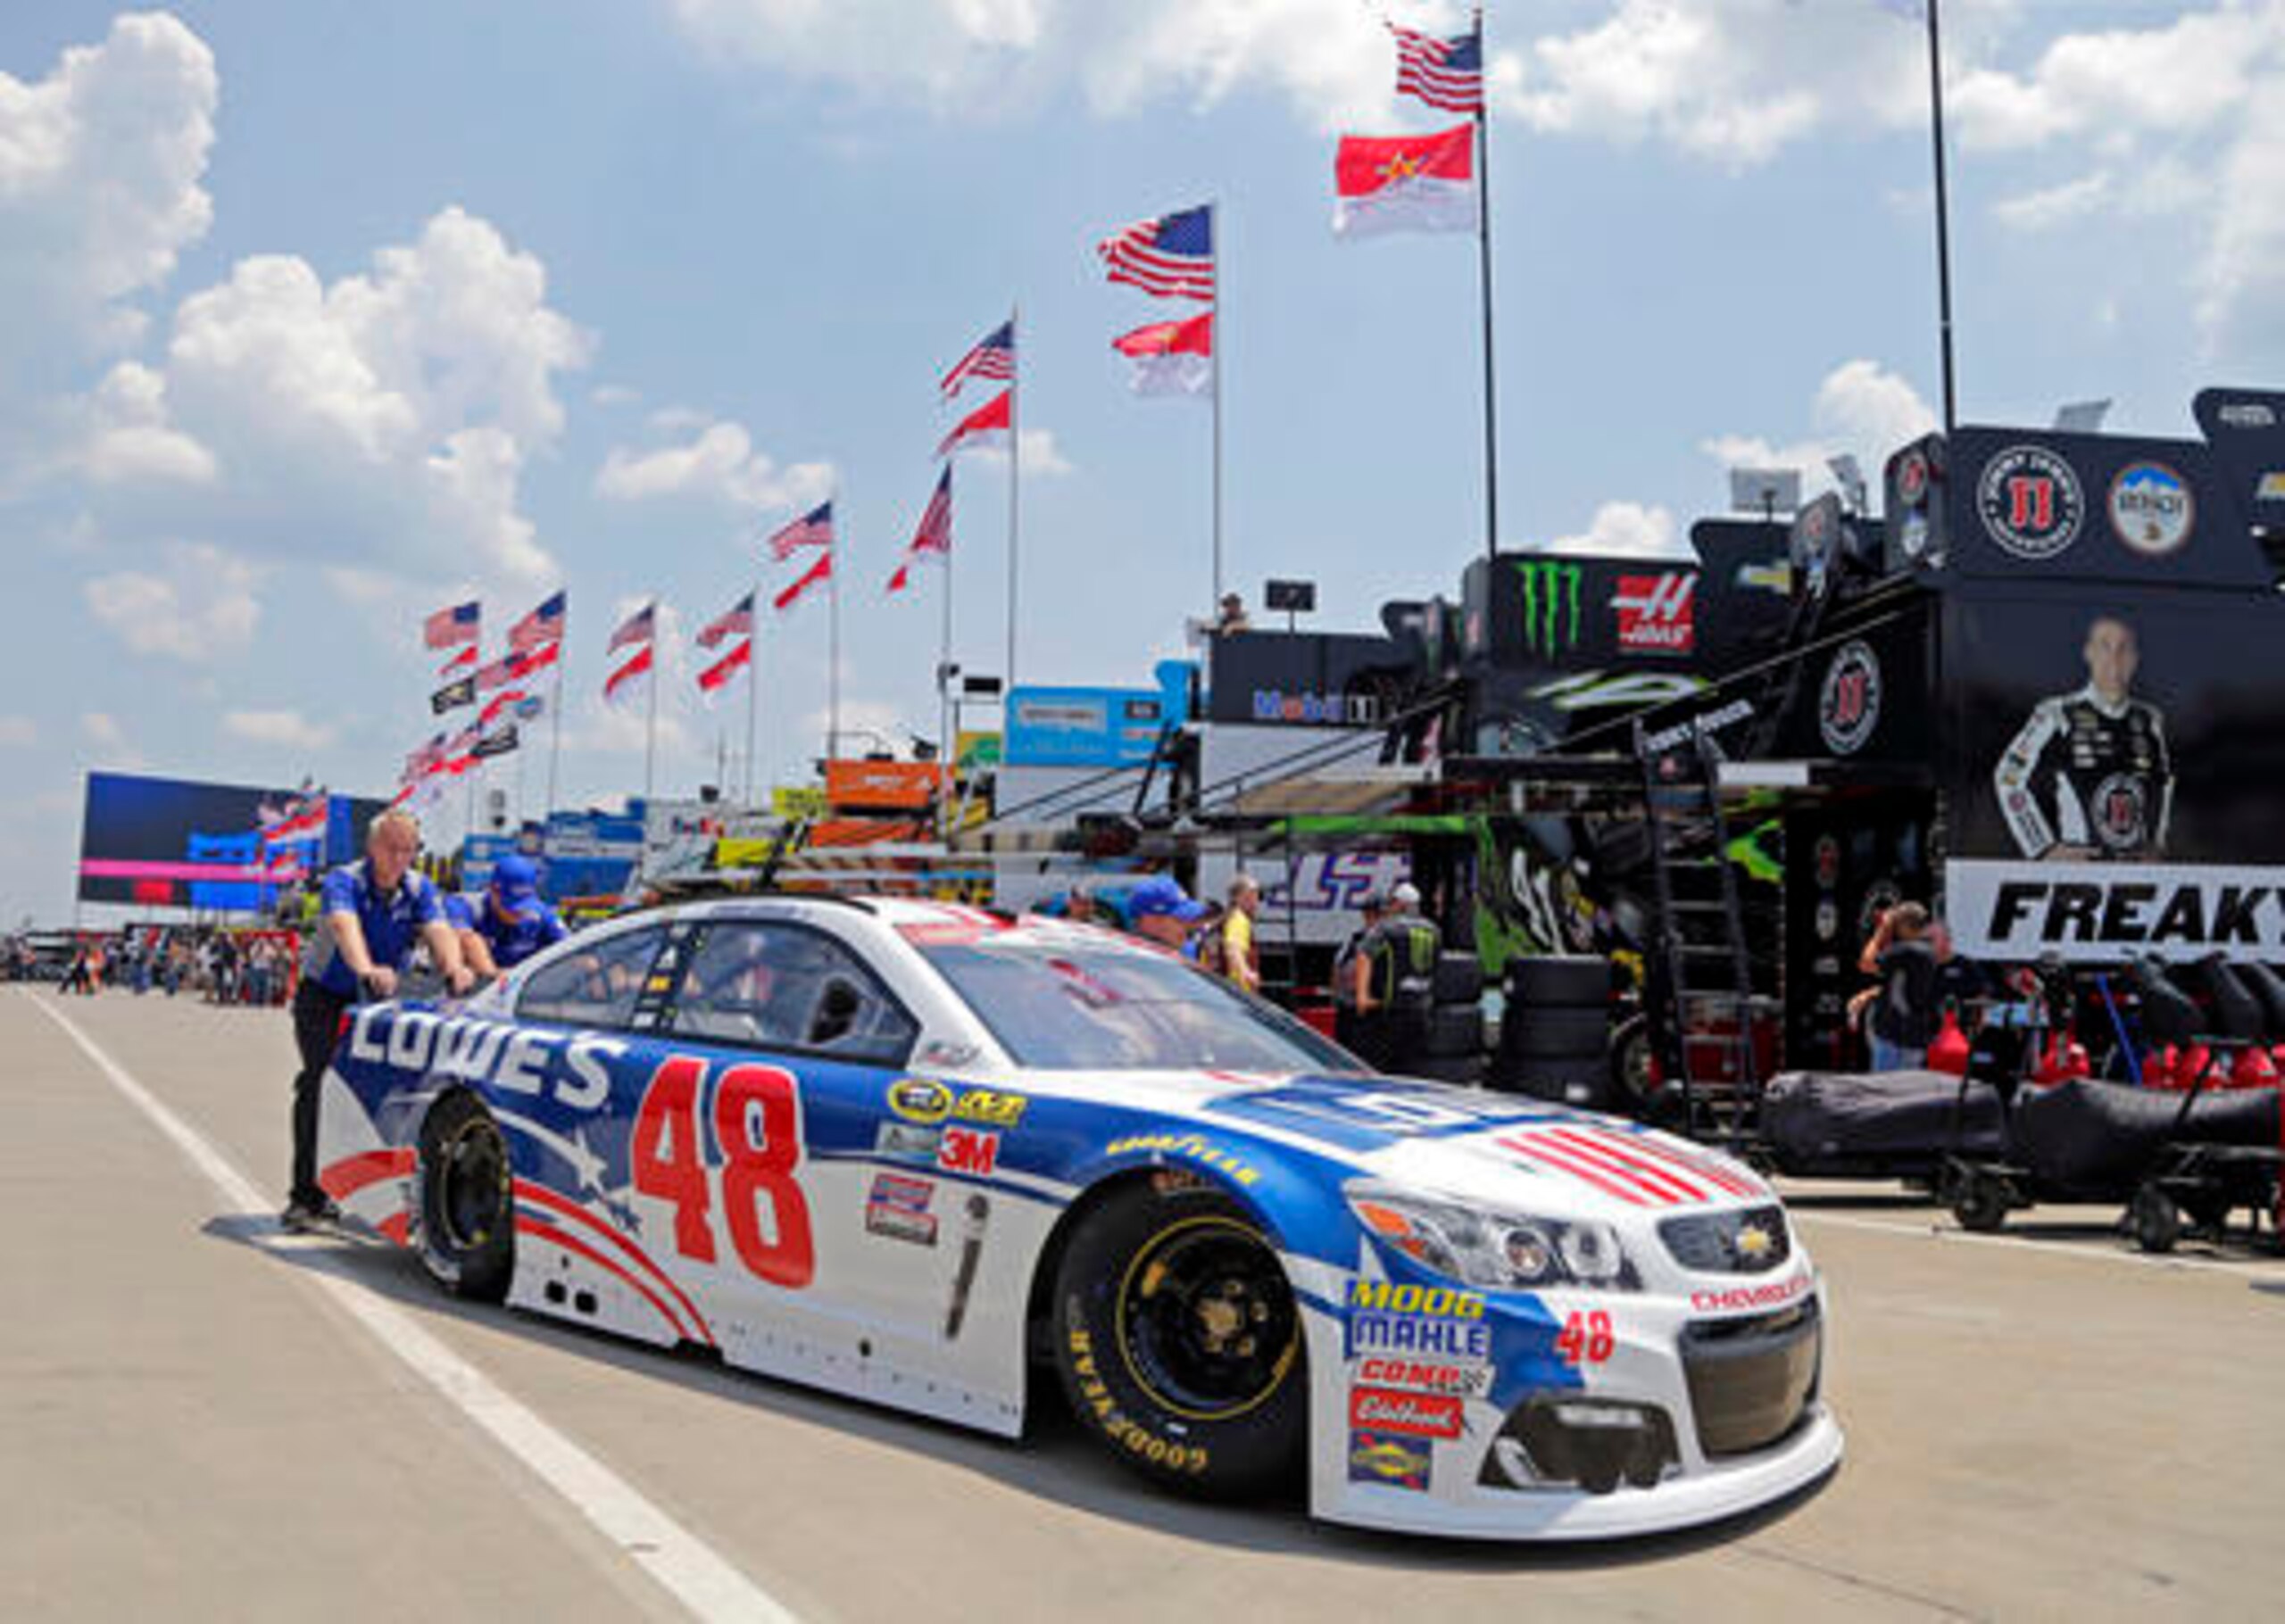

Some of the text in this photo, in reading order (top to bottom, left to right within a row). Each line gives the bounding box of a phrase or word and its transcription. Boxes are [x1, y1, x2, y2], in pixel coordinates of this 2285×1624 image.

[1987, 881, 2285, 944] FREAK
[631, 1055, 816, 1289] 48
[940, 1127, 998, 1175] 3M
[1351, 1283, 1486, 1319] MOOG
[1356, 1317, 1487, 1358] MAHLE
[1557, 1311, 1615, 1364] 48
[1069, 1328, 1208, 1472] GOODYEAR
